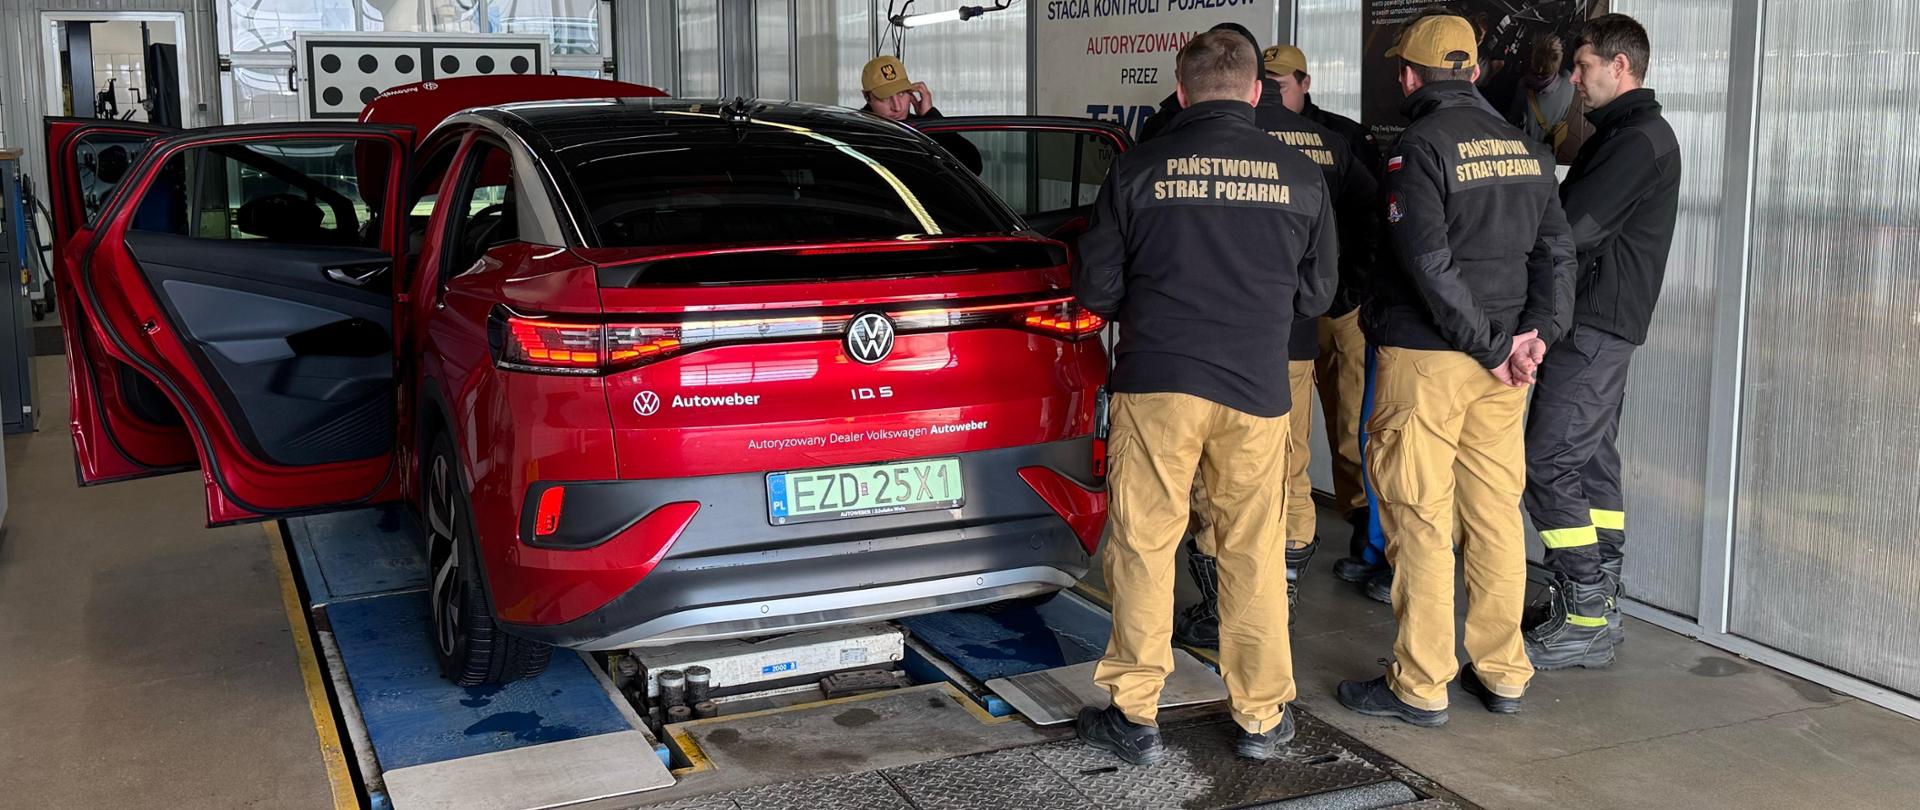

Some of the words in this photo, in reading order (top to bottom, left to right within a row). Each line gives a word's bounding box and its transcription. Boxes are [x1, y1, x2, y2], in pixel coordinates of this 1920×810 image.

[1047, 1, 1089, 20] STACJA
[1094, 0, 1159, 17] KONTROLI
[1086, 31, 1200, 55] AUTORYZOWAN
[1121, 68, 1158, 84] PRZEZ
[1267, 131, 1324, 147] TWOWA
[1167, 154, 1279, 180] PAŃSTWOWA
[672, 392, 760, 408] Autoweber
[748, 435, 827, 450] Autoryzowany
[830, 431, 864, 445] Dealer
[866, 426, 928, 442] Volkswagen
[930, 420, 988, 435] Autoweber
[793, 472, 860, 513] EZD
[873, 464, 950, 504] 25X1
[773, 501, 786, 511] PL
